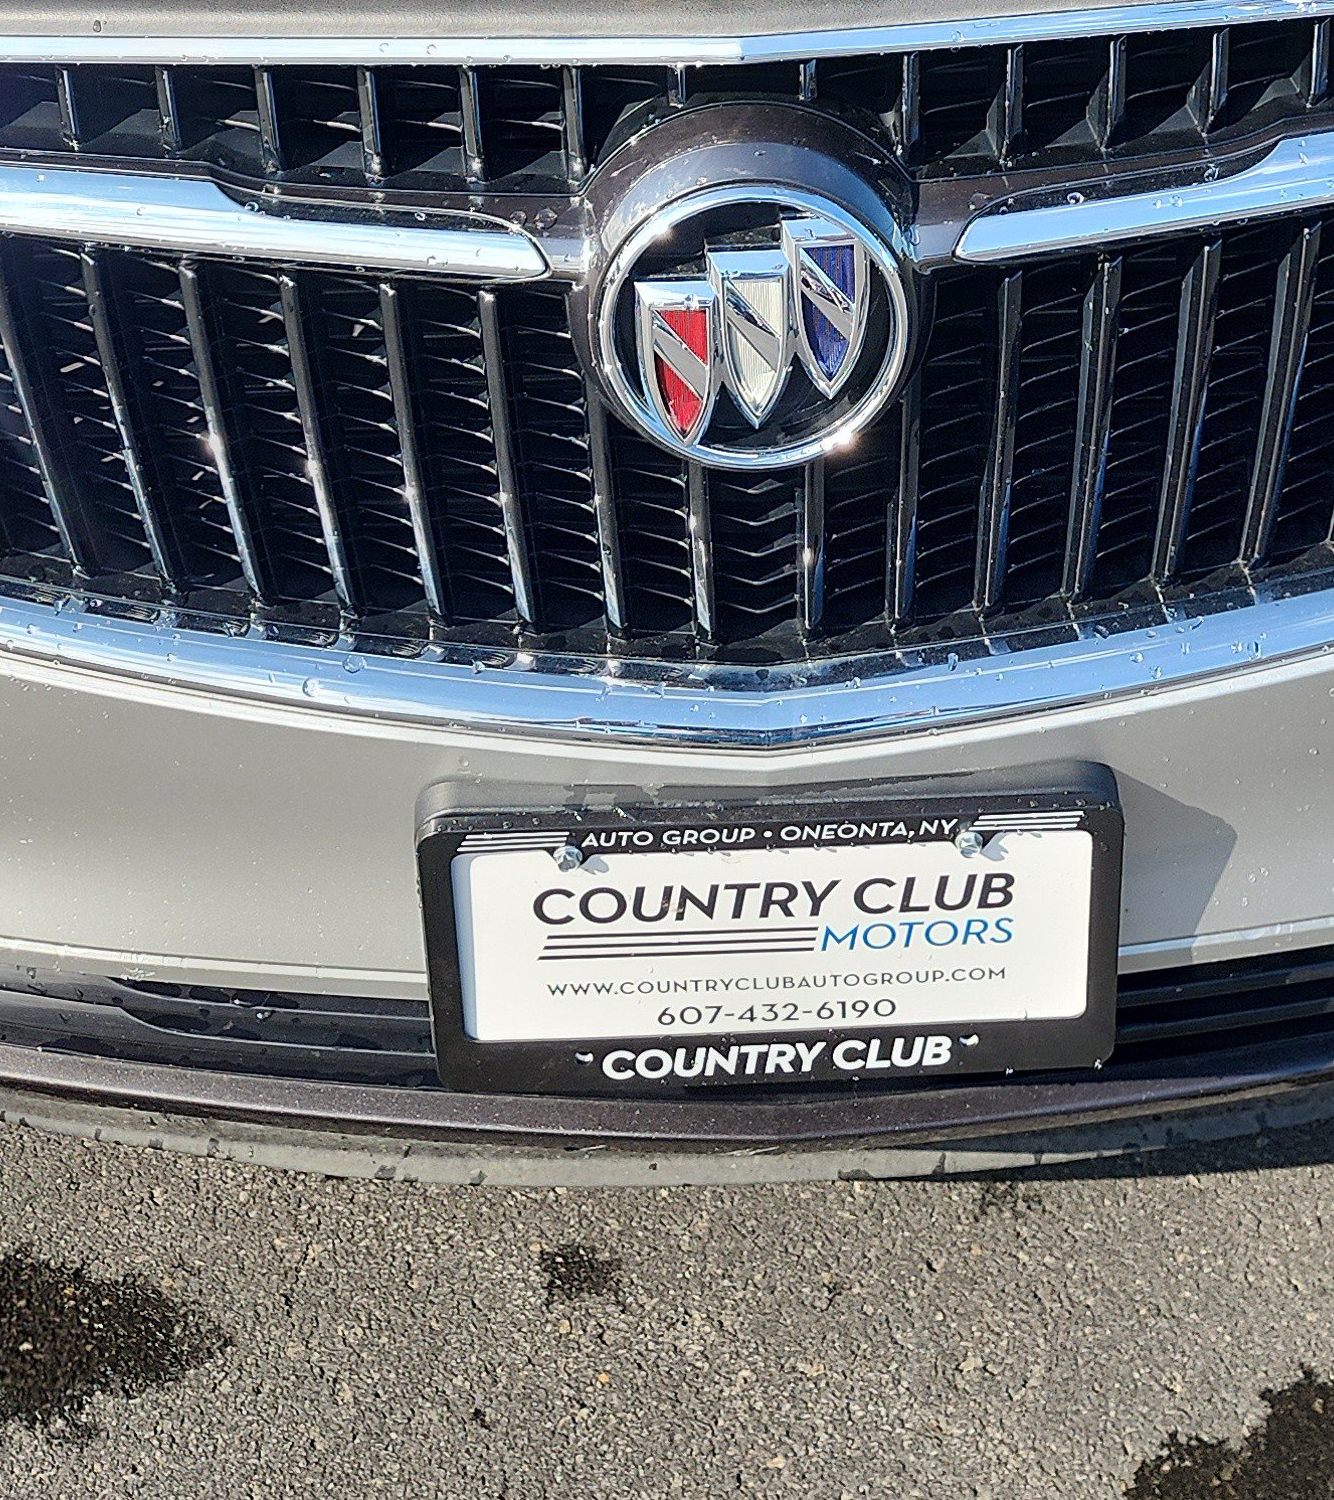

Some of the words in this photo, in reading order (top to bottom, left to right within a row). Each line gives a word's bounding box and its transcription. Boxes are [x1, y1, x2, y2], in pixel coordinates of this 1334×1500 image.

[580, 830, 654, 848] AUTO
[662, 827, 756, 845] GROUP
[531, 879, 843, 926] COUNTRY
[852, 871, 1016, 915] CLUB
[820, 917, 1015, 952] MOTORS
[546, 966, 1007, 996] WWW.COUNTRYCLUBAUTOGROUP.COM
[657, 998, 898, 1027] 607-432-6190
[601, 1041, 831, 1080] COUNTRY
[832, 1034, 954, 1073] CLUB
